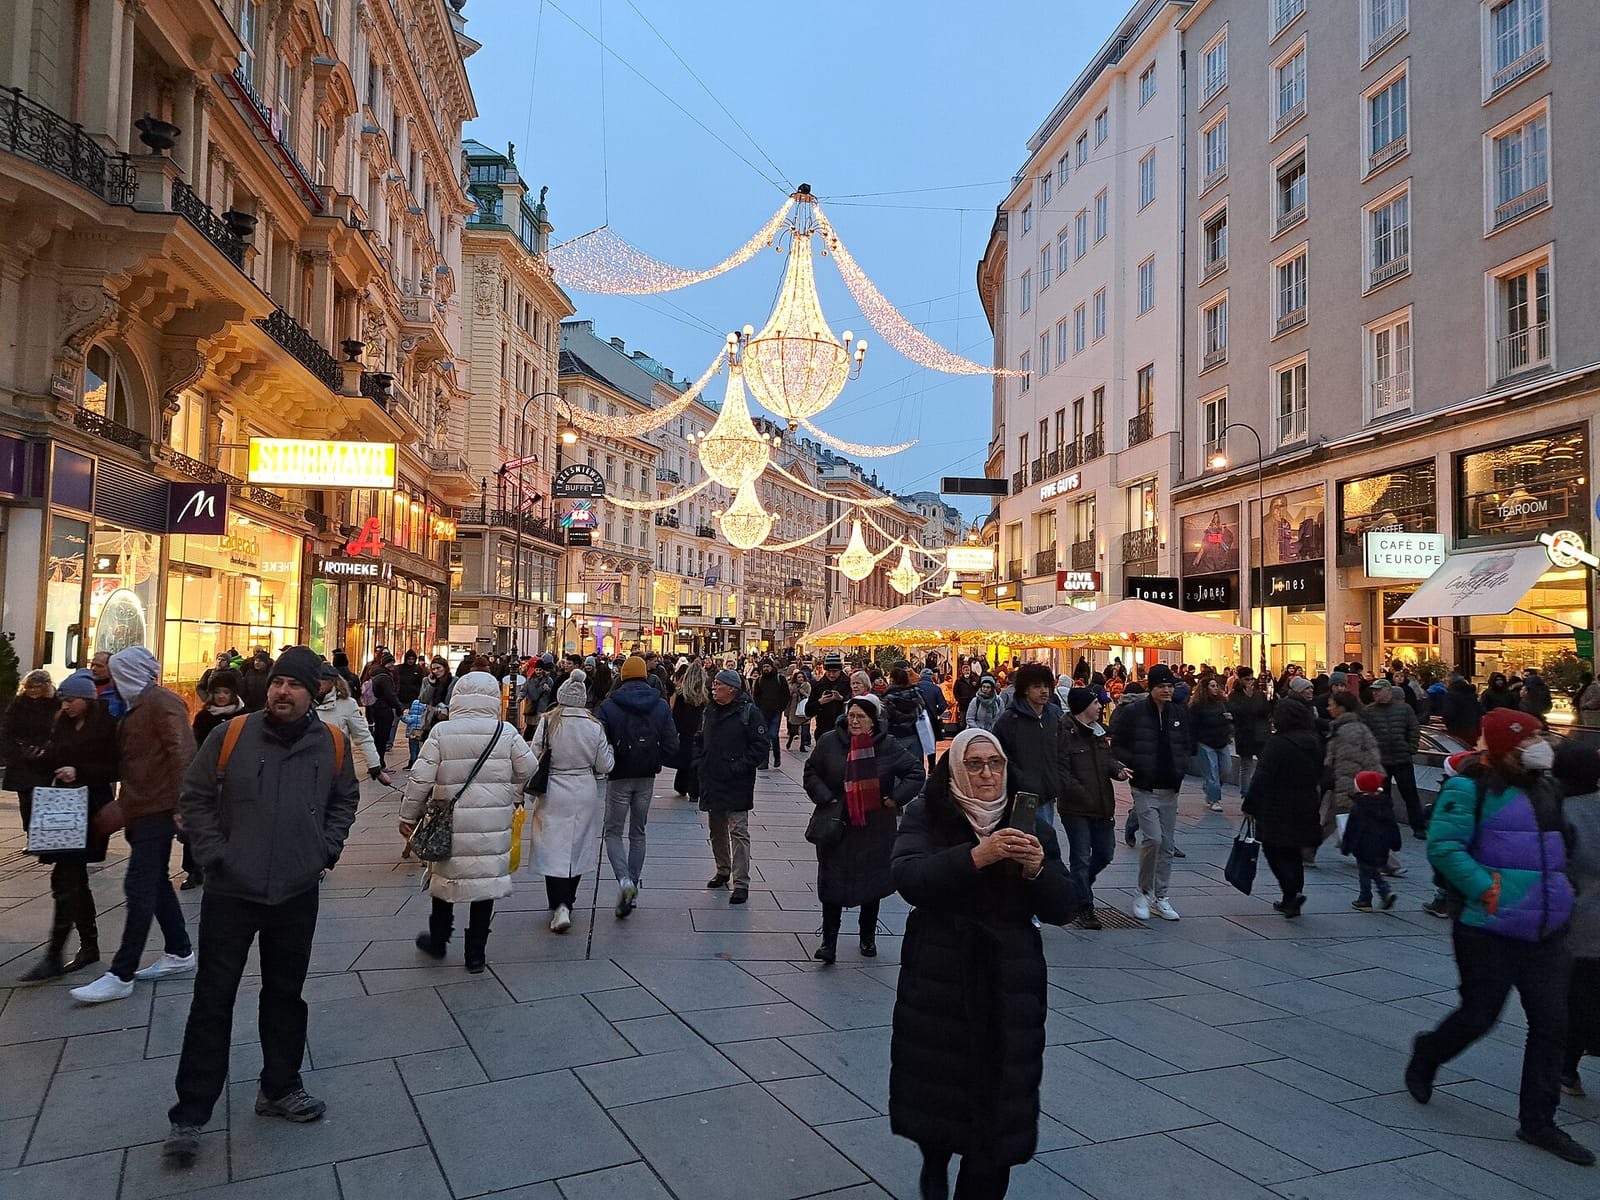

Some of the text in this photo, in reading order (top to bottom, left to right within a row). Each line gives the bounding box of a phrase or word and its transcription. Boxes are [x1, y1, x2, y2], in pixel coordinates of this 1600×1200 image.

[565, 484, 594, 492] BUFFET
[1040, 474, 1079, 500] FIVE GUYS
[1497, 500, 1548, 518] TEAROOM
[1419, 541, 1435, 551] DE
[1374, 554, 1441, 565] L'EUROPE
[325, 560, 378, 576] APOTHEKE
[1066, 572, 1092, 581] FIVE
[1063, 580, 1095, 591] GUYS
[1270, 577, 1305, 596] Jones
[1197, 585, 1225, 602] Jones
